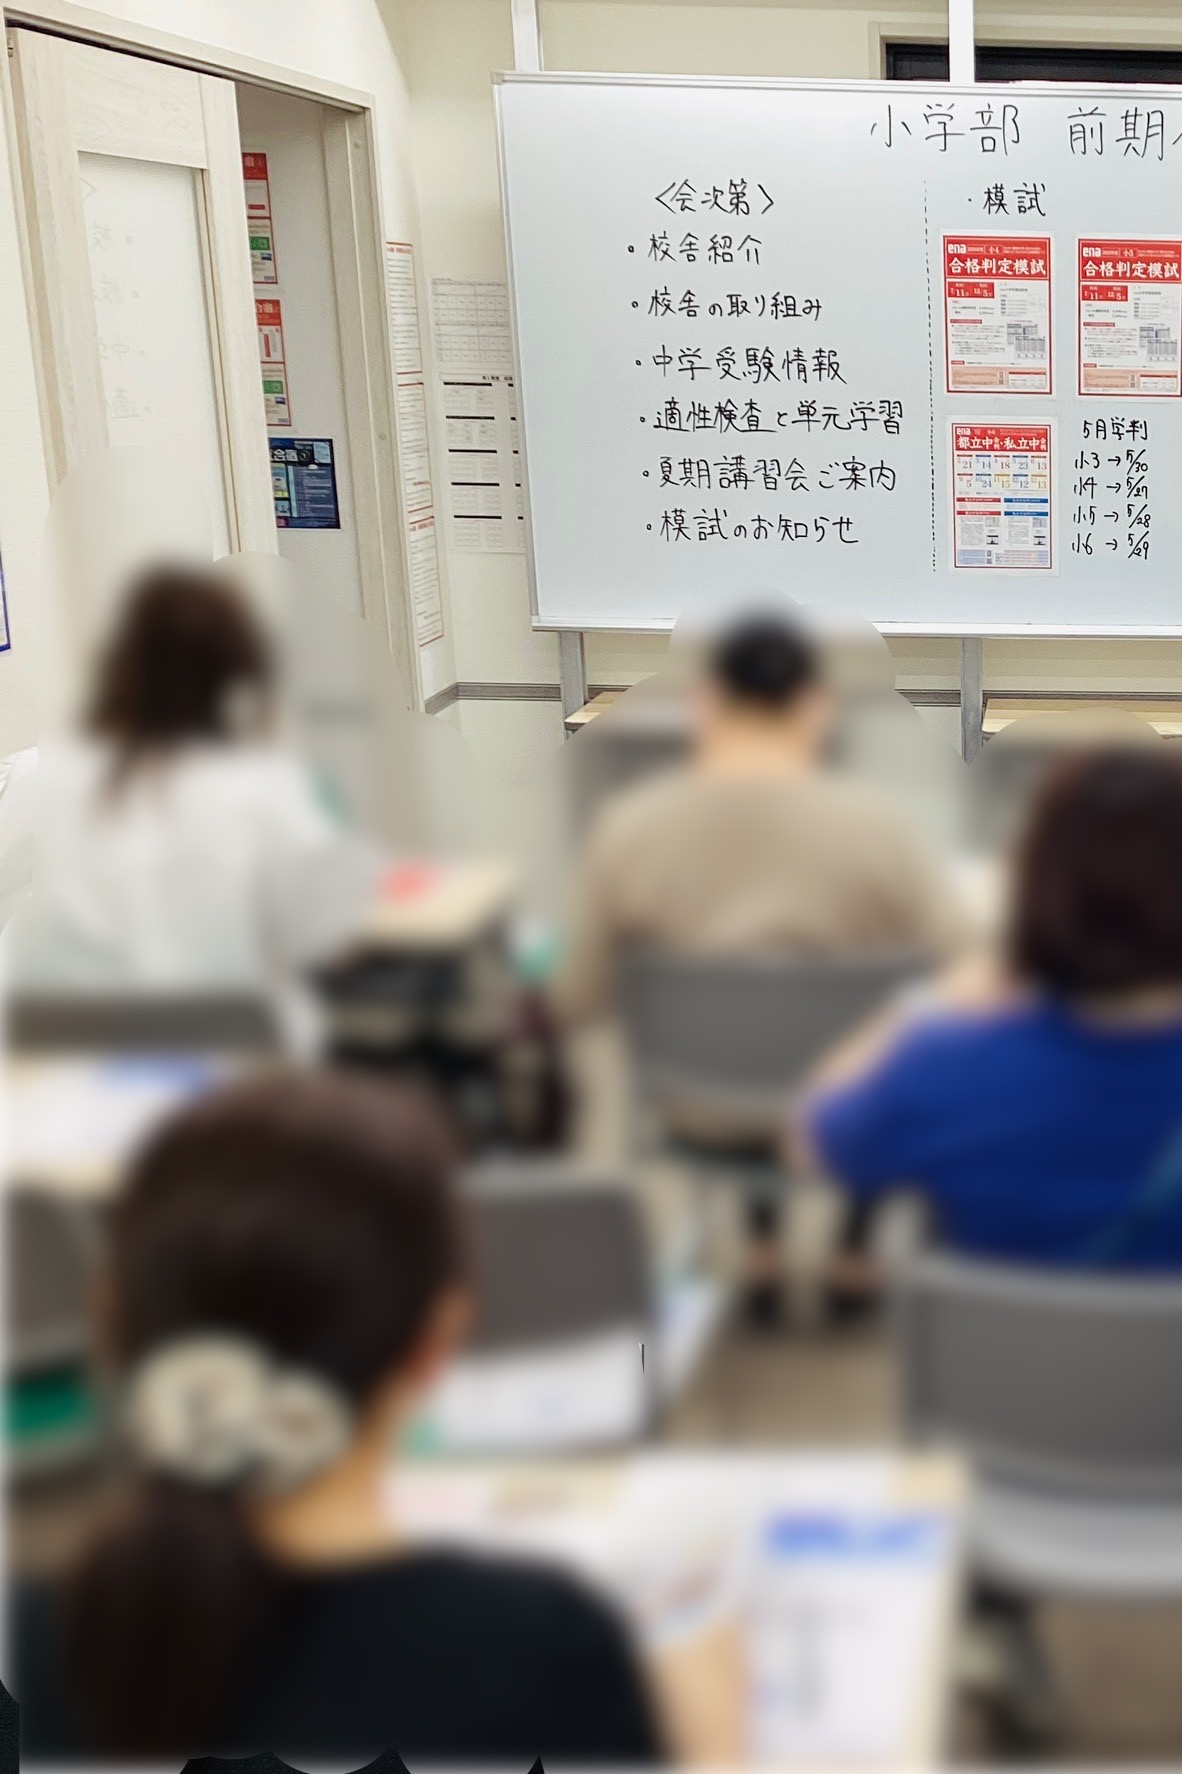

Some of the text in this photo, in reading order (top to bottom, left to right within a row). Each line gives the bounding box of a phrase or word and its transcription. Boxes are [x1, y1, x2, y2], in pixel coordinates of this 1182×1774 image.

[871, 103, 1019, 156] 小学部
[948, 244, 966, 254] ena
[1083, 247, 1101, 257] ena
[949, 257, 1046, 275] 合格判定模試
[1083, 260, 1180, 278] 合格判定模試
